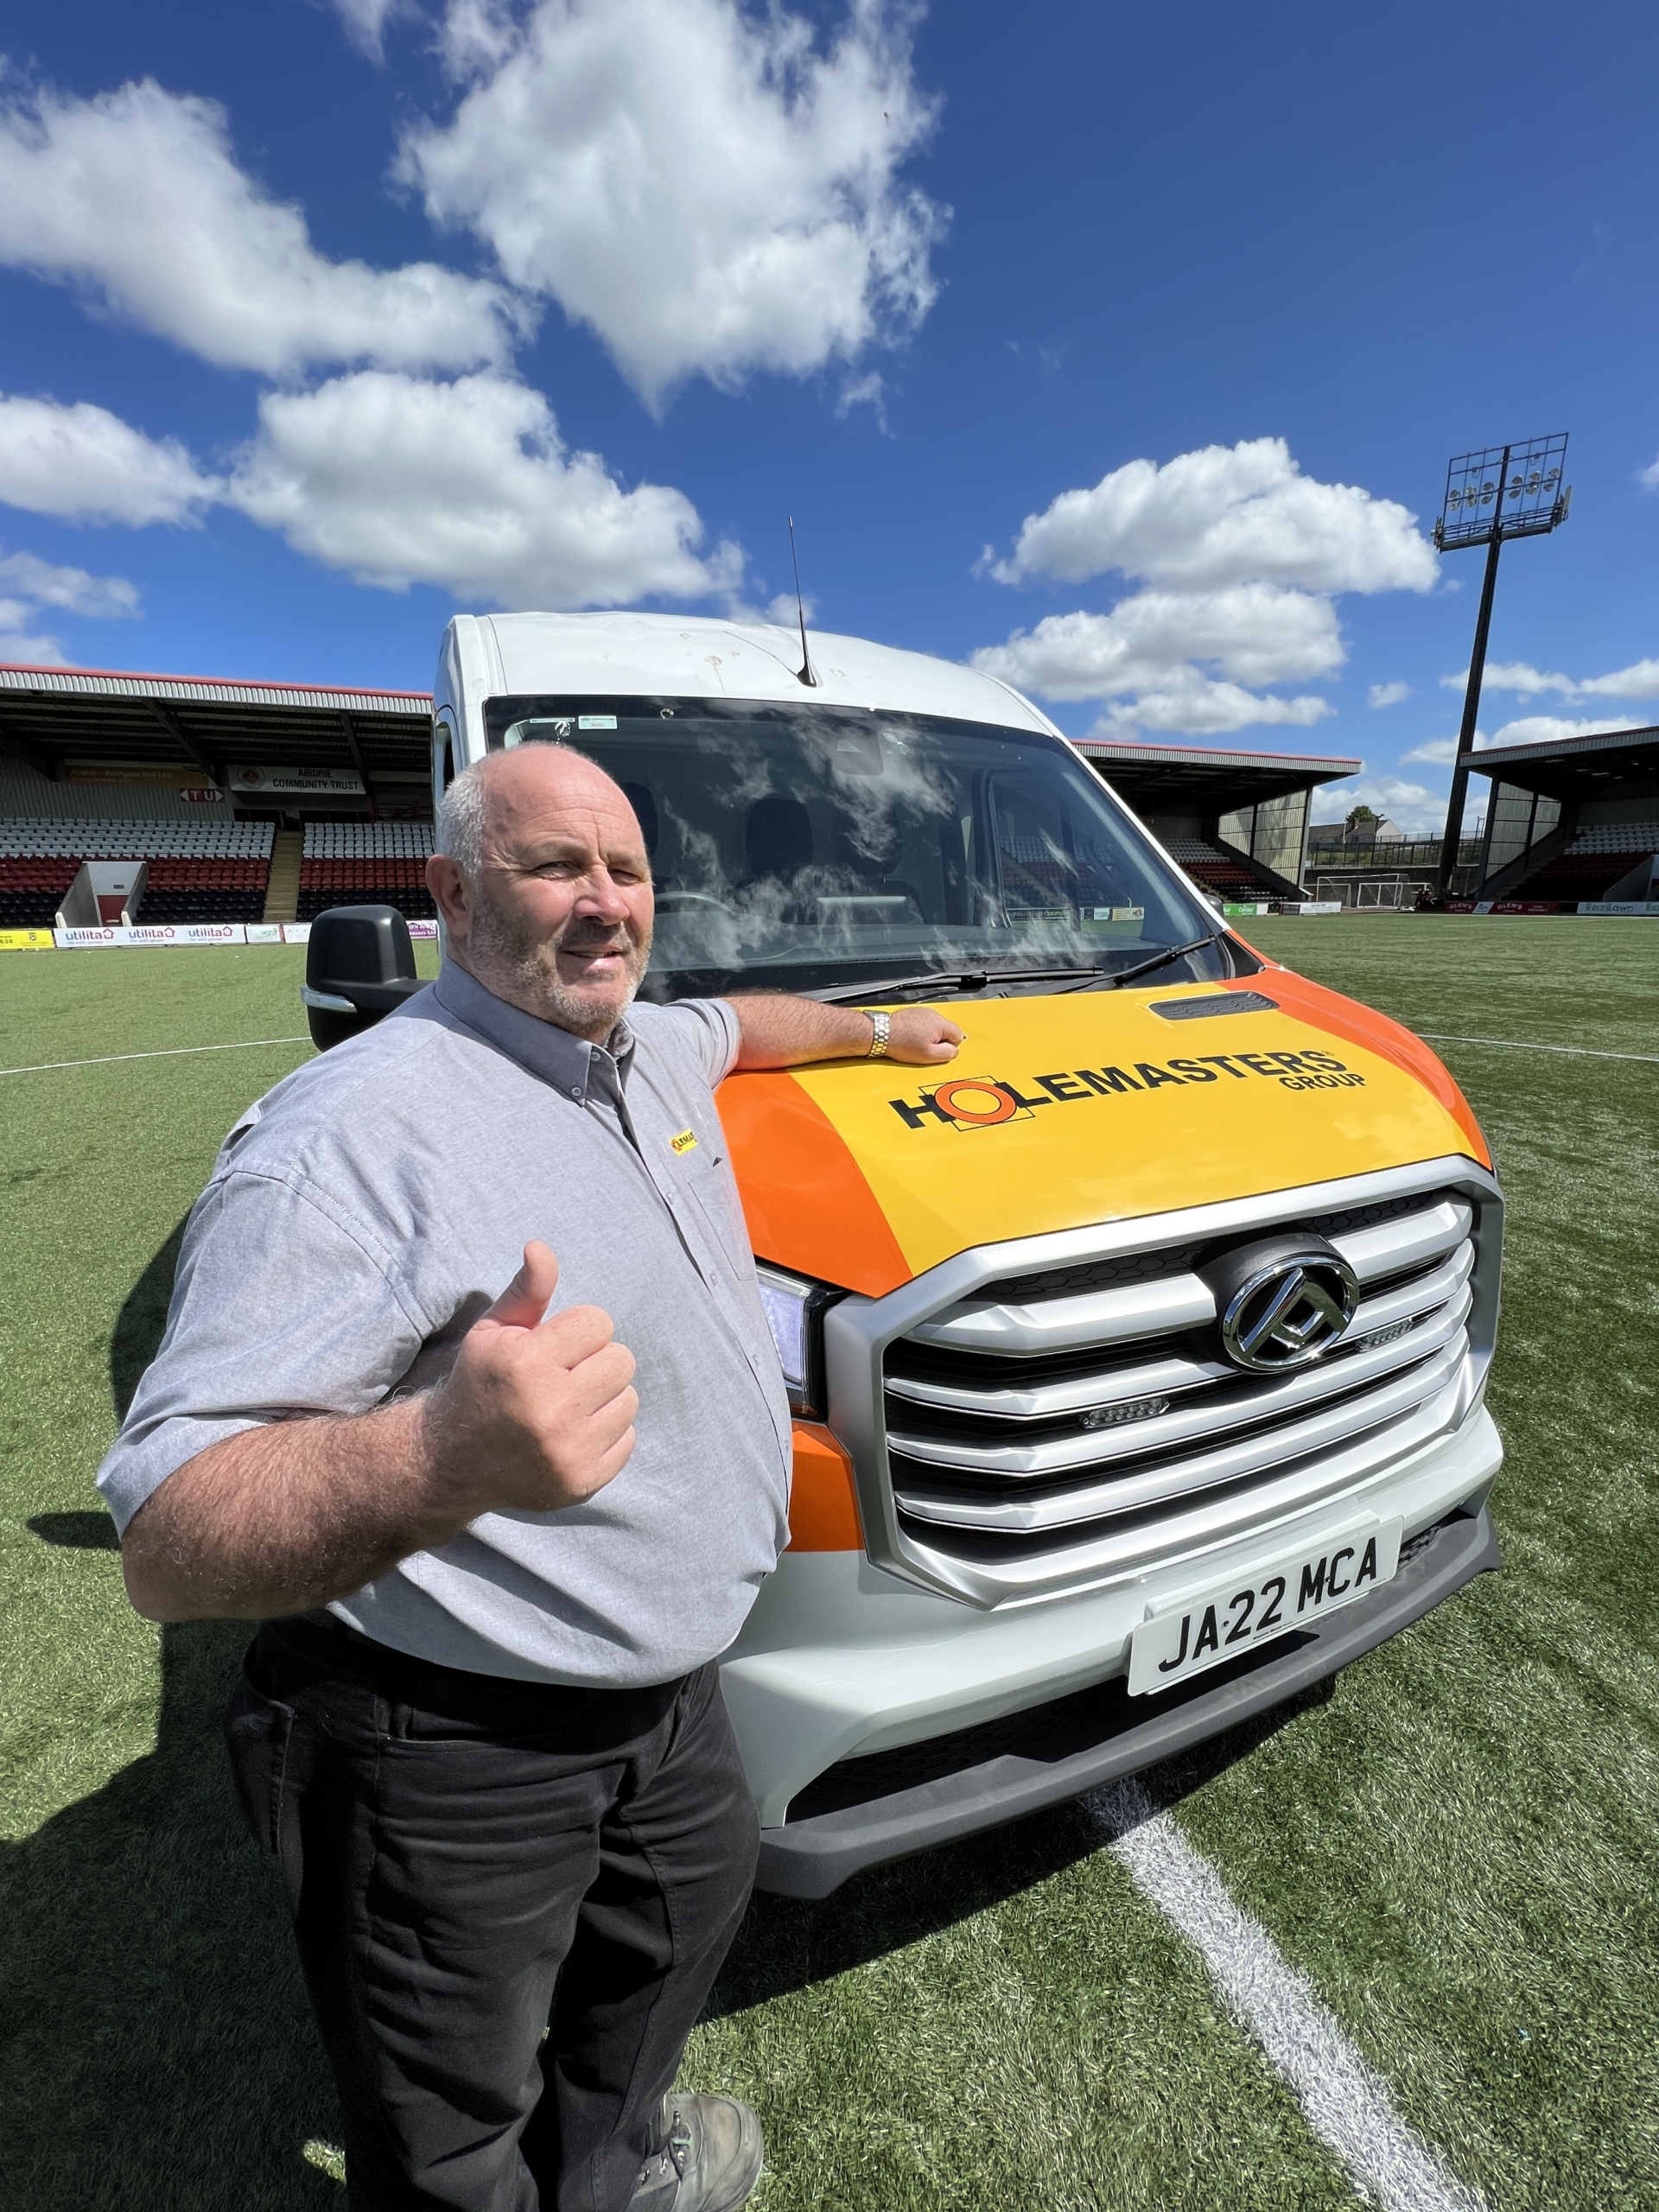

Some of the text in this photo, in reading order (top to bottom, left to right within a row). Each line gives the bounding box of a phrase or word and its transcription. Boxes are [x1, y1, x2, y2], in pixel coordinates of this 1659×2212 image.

[70, 768, 97, 777] Airdrie
[105, 769, 141, 779] Bathgate
[298, 768, 334, 779] AIRDRIE
[272, 779, 359, 790] COMMUNITY TRUST
[189, 790, 213, 801] T U
[1586, 903, 1634, 912] EaziLawn
[66, 931, 103, 940] utilita
[129, 929, 164, 938] utilita
[188, 927, 223, 938] utilita
[1277, 1071, 1367, 1092] GROUP
[888, 1049, 1348, 1129] HOLEMASTERS
[1158, 1535, 1376, 1673] JA22 MCA
